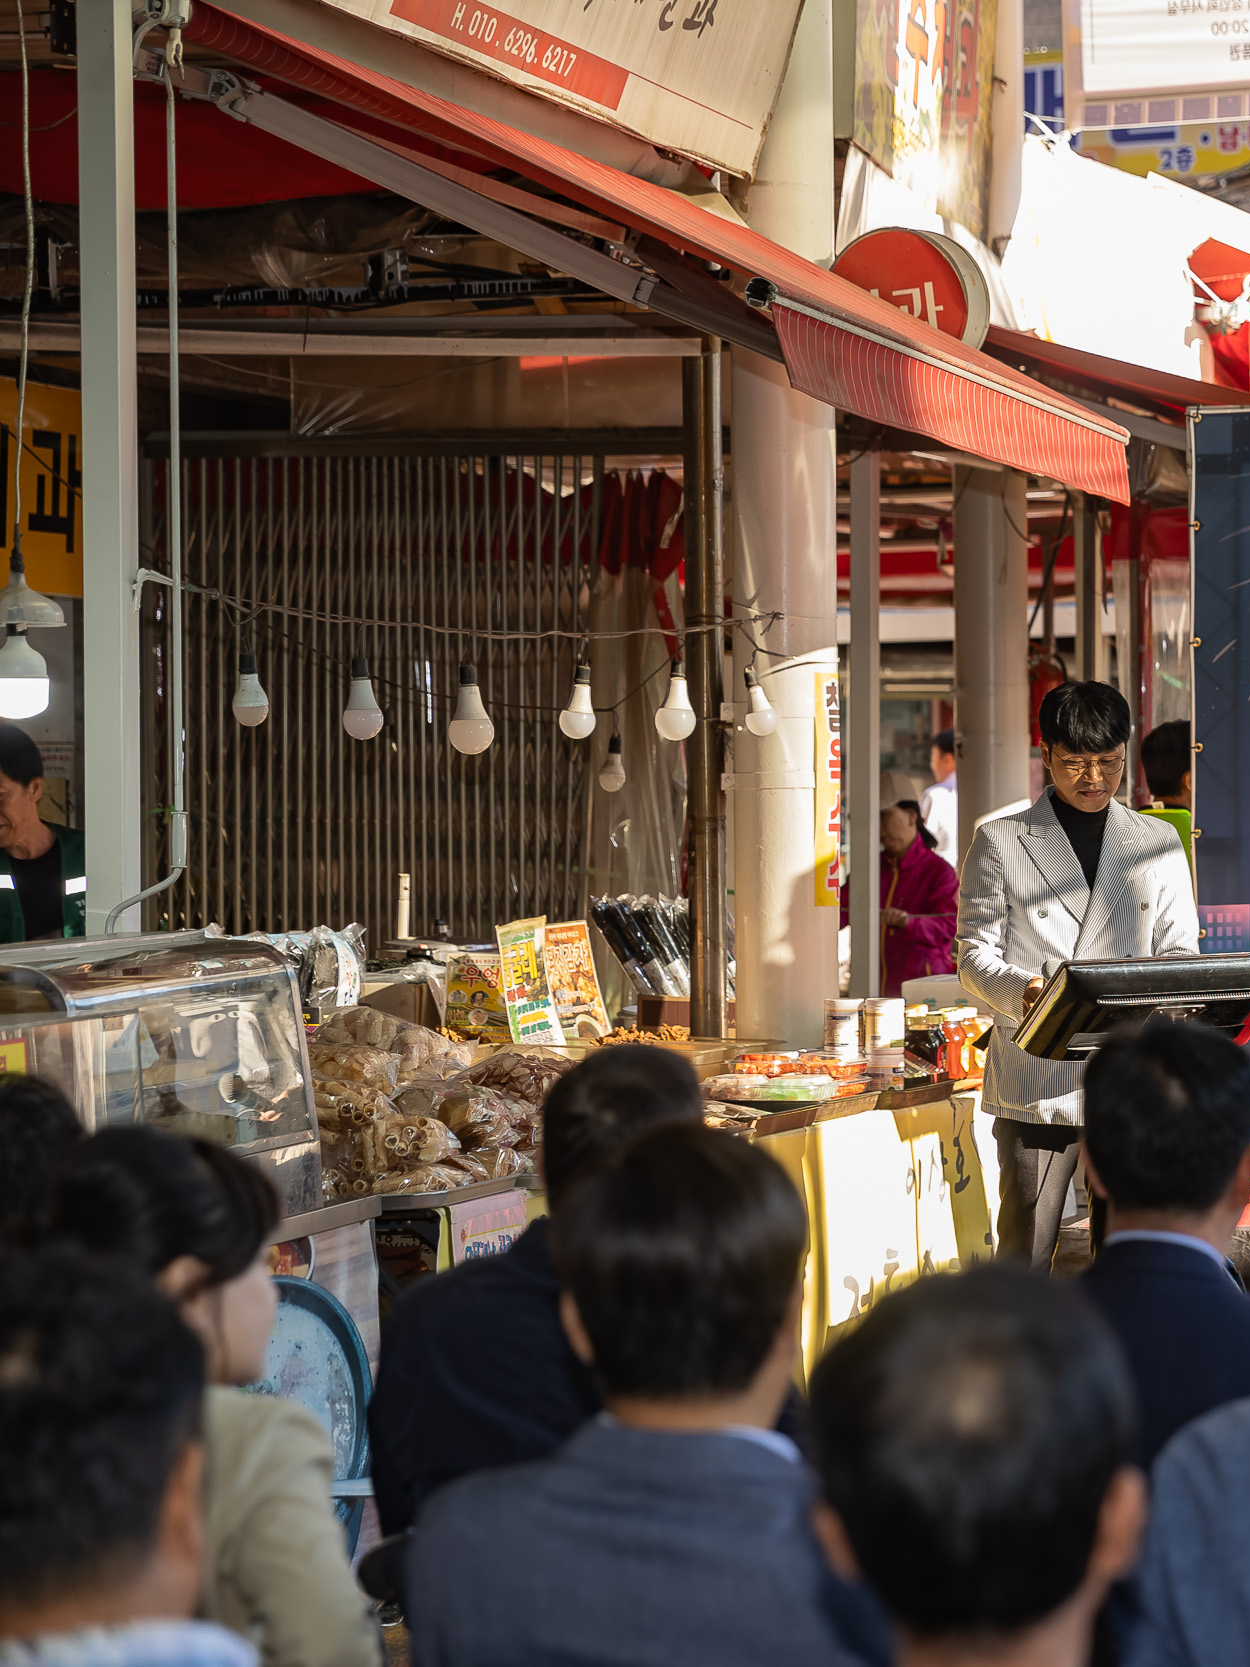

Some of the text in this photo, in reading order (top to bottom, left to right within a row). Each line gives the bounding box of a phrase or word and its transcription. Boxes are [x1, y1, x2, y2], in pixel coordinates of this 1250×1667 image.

[450, 2, 467, 31] H.
[542, 44, 577, 77] 6217
[1159, 146, 1195, 172] 2층
[501, 939, 538, 989] 둥굴레
